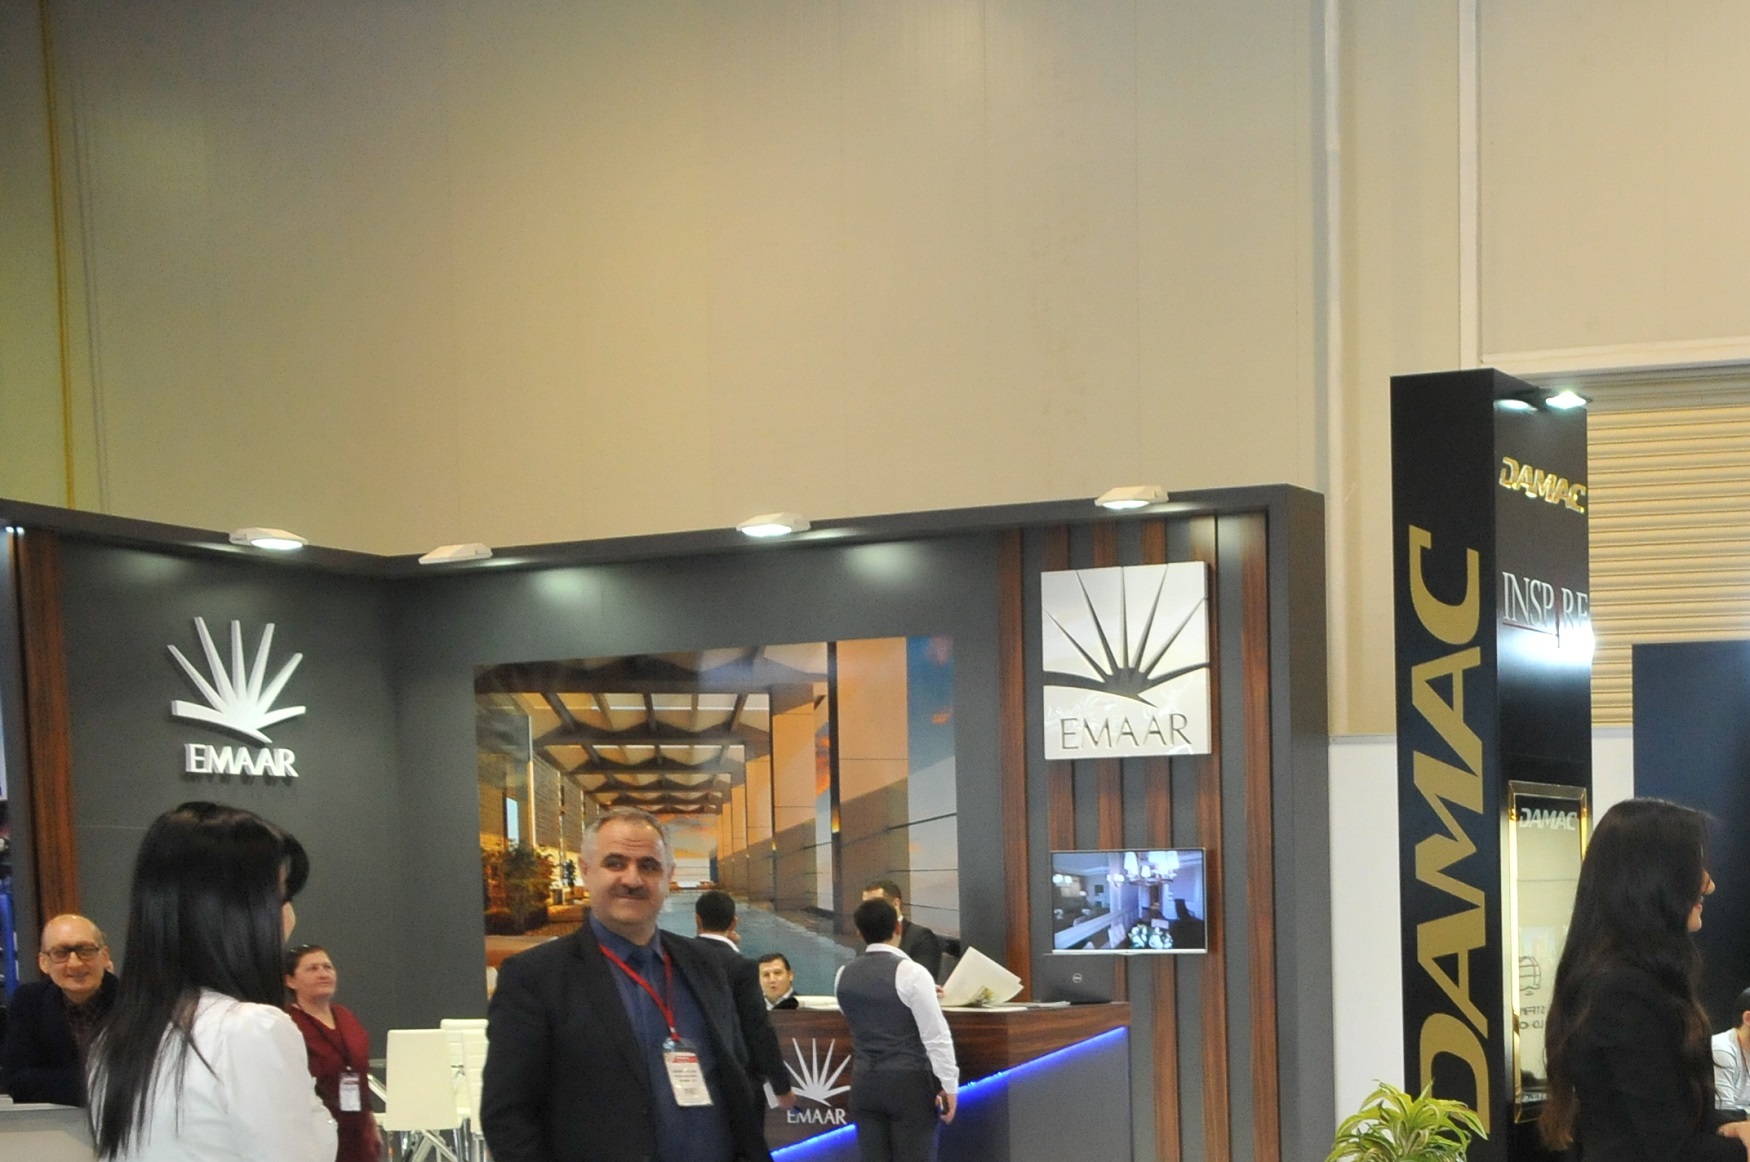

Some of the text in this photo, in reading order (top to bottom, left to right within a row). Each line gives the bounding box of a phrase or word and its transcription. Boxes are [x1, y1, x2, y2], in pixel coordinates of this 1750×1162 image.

[1499, 456, 1586, 513] DAMAC
[1060, 713, 1192, 750] EMAAR
[184, 743, 299, 777] EMAAR
[1408, 524, 1490, 1136] DAMAC
[1519, 807, 1578, 831] DAMAC
[786, 1108, 848, 1125] EMAAR
